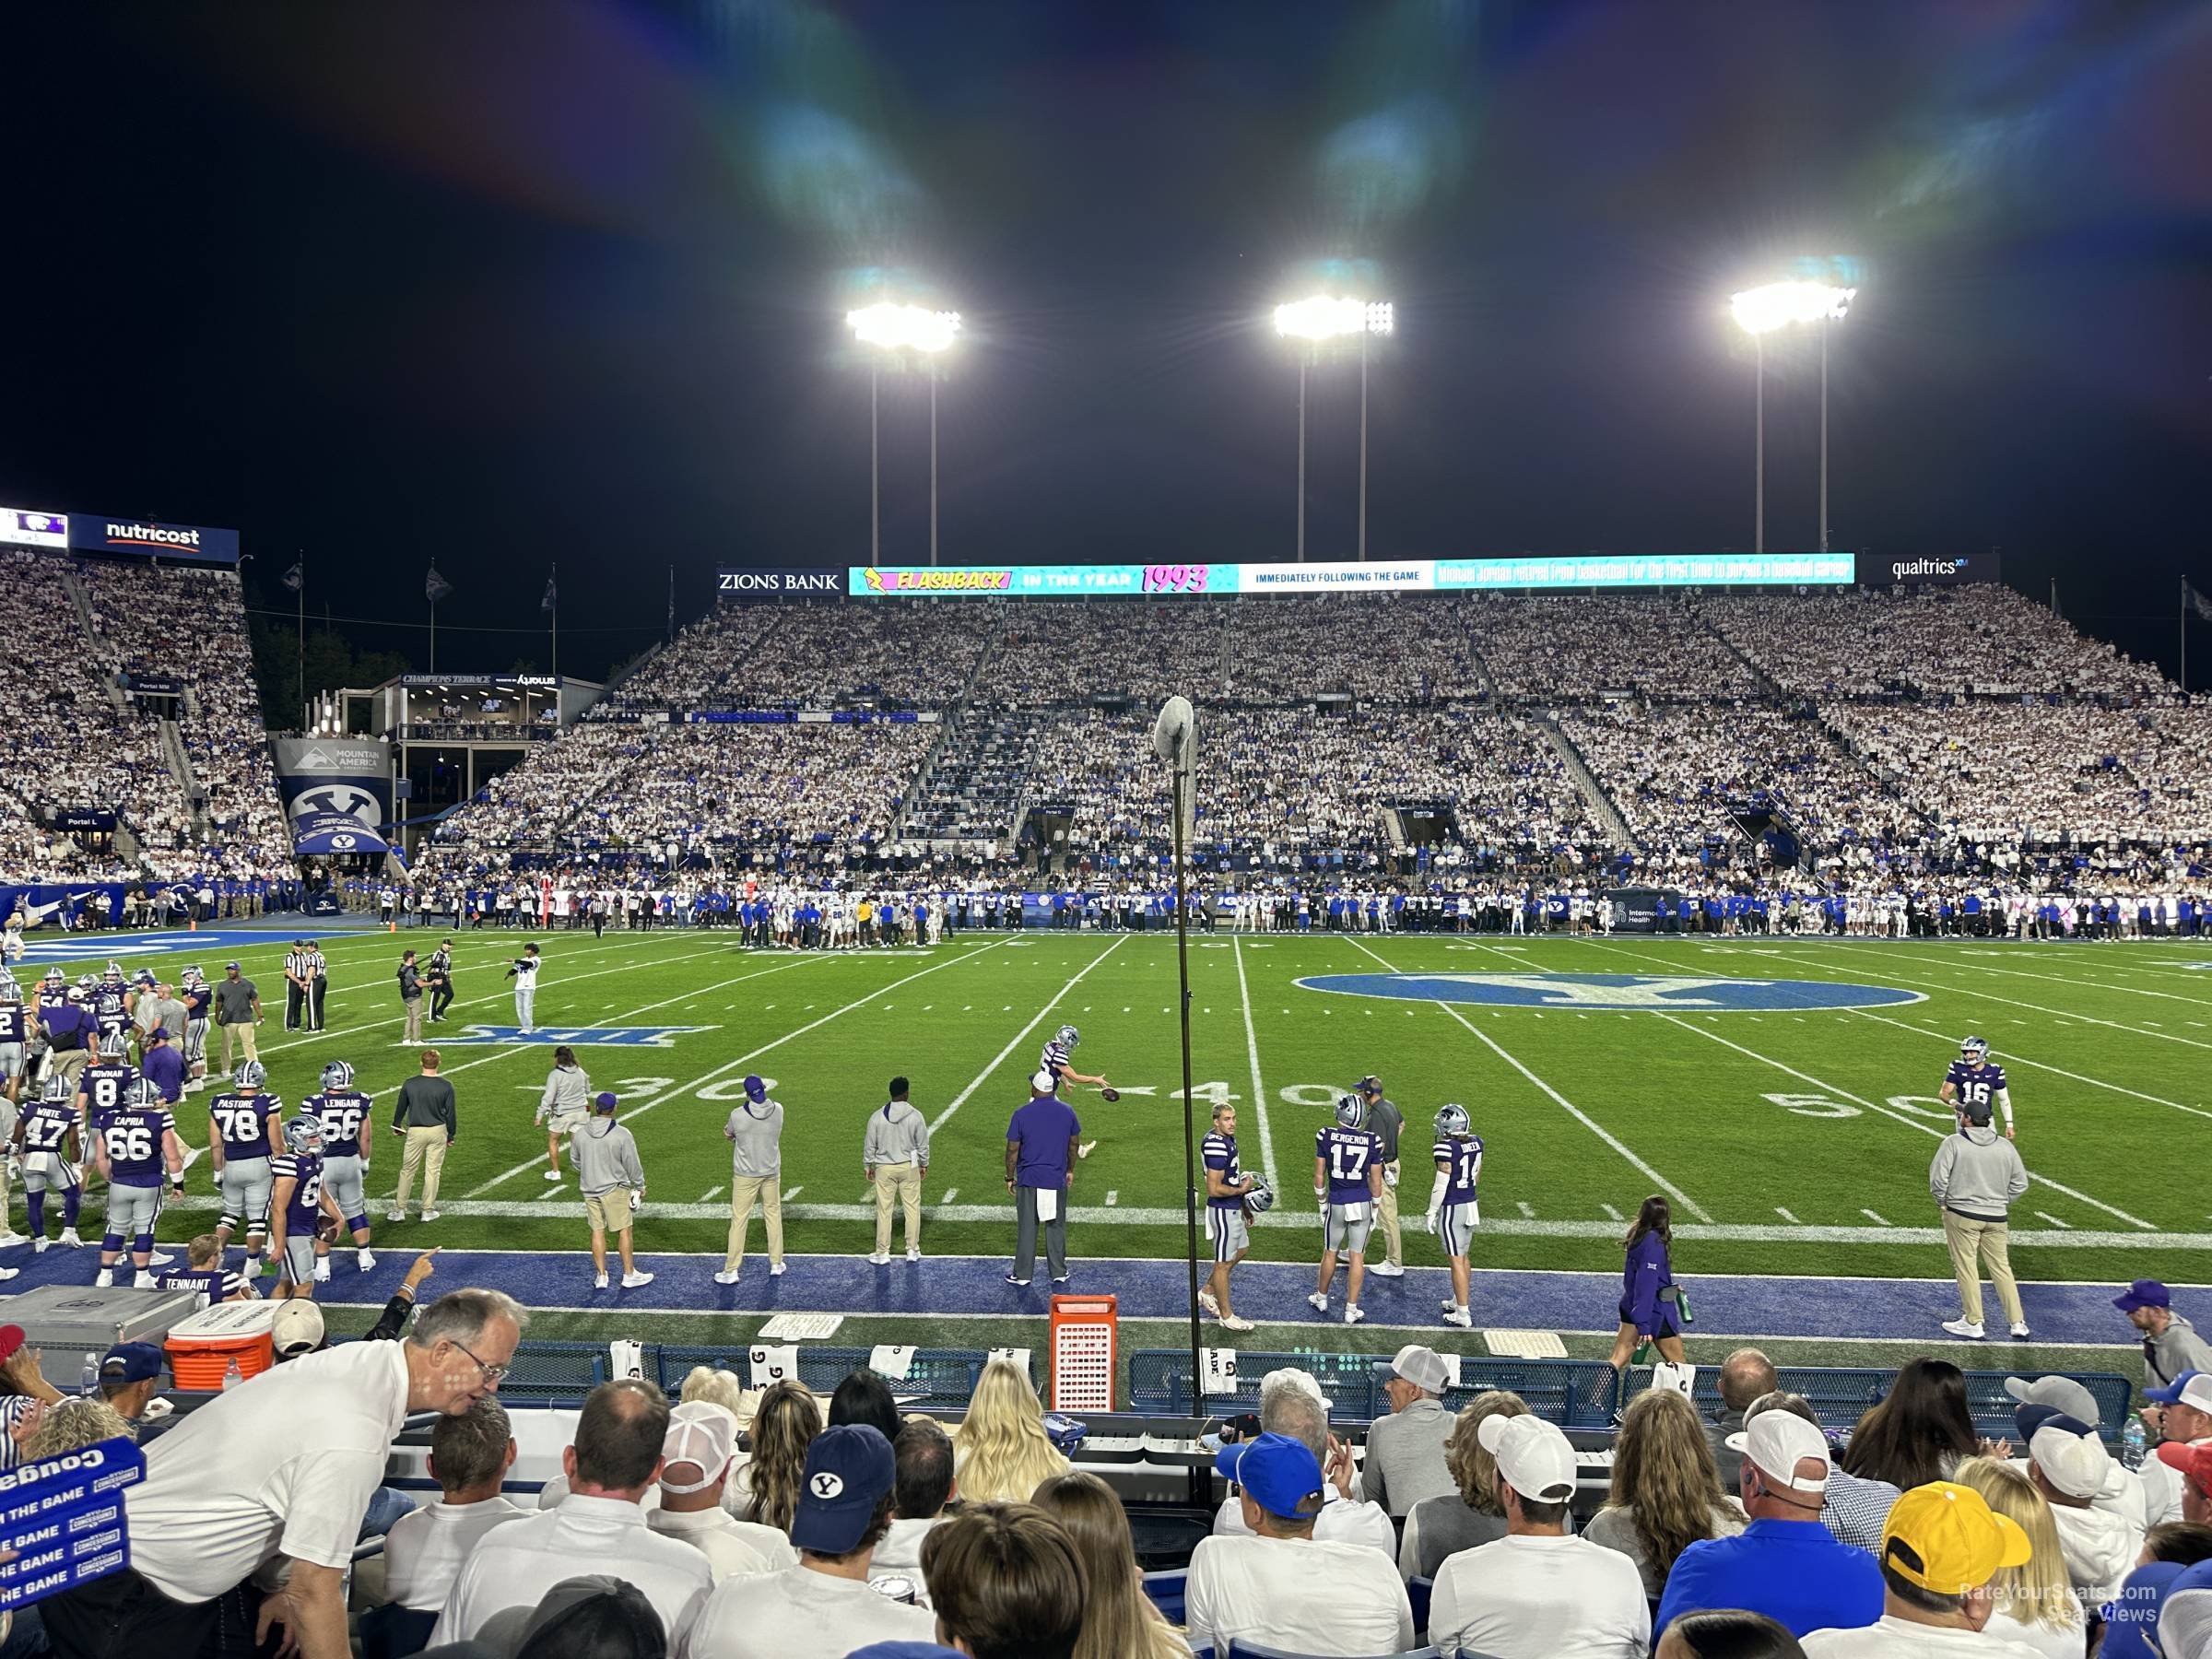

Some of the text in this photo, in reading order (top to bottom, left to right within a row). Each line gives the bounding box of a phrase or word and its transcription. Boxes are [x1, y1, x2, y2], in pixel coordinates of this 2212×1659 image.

[107, 524, 200, 545] nutricost
[1023, 564, 1209, 592] IN THE YEAR 1993
[1255, 571, 1420, 582] IMMEDIATELY FOLLOWING THE GAME
[1892, 558, 1955, 580] qualtrics
[719, 573, 840, 590] ZIONS BANK
[897, 571, 1005, 590] FLASHBACK
[403, 675, 491, 684] CHAMPIONS TERRACE
[517, 674, 556, 685] smarty
[337, 750, 380, 759] MOUNTAIN
[339, 759, 377, 767] AMERICA
[40, 995, 64, 1007] 54
[91, 1069, 124, 1077] BOWMAN
[95, 1078, 117, 1107] 8
[1962, 1081, 1991, 1105] 16
[36, 1107, 62, 1119] WHITE
[218, 1099, 253, 1109] PASTORE
[324, 1099, 360, 1109] LEINGANG
[114, 1116, 145, 1126] CAPRIA
[214, 1108, 260, 1142] 78
[321, 1109, 362, 1142] 56
[25, 1116, 70, 1147] 47
[1330, 1132, 1370, 1146] BERGERON
[105, 1127, 152, 1161] 66
[1330, 1144, 1369, 1180] 17
[167, 1278, 211, 1289] TENNANT
[752, 1350, 766, 1363] G
[770, 1366, 783, 1379] G
[816, 1474, 840, 1497] Y
[9, 1501, 39, 1520] THE
[41, 1486, 85, 1510] GAME
[16, 1524, 60, 1547] GAME
[20, 1547, 65, 1572] GAME
[25, 1570, 68, 1595] GAME
